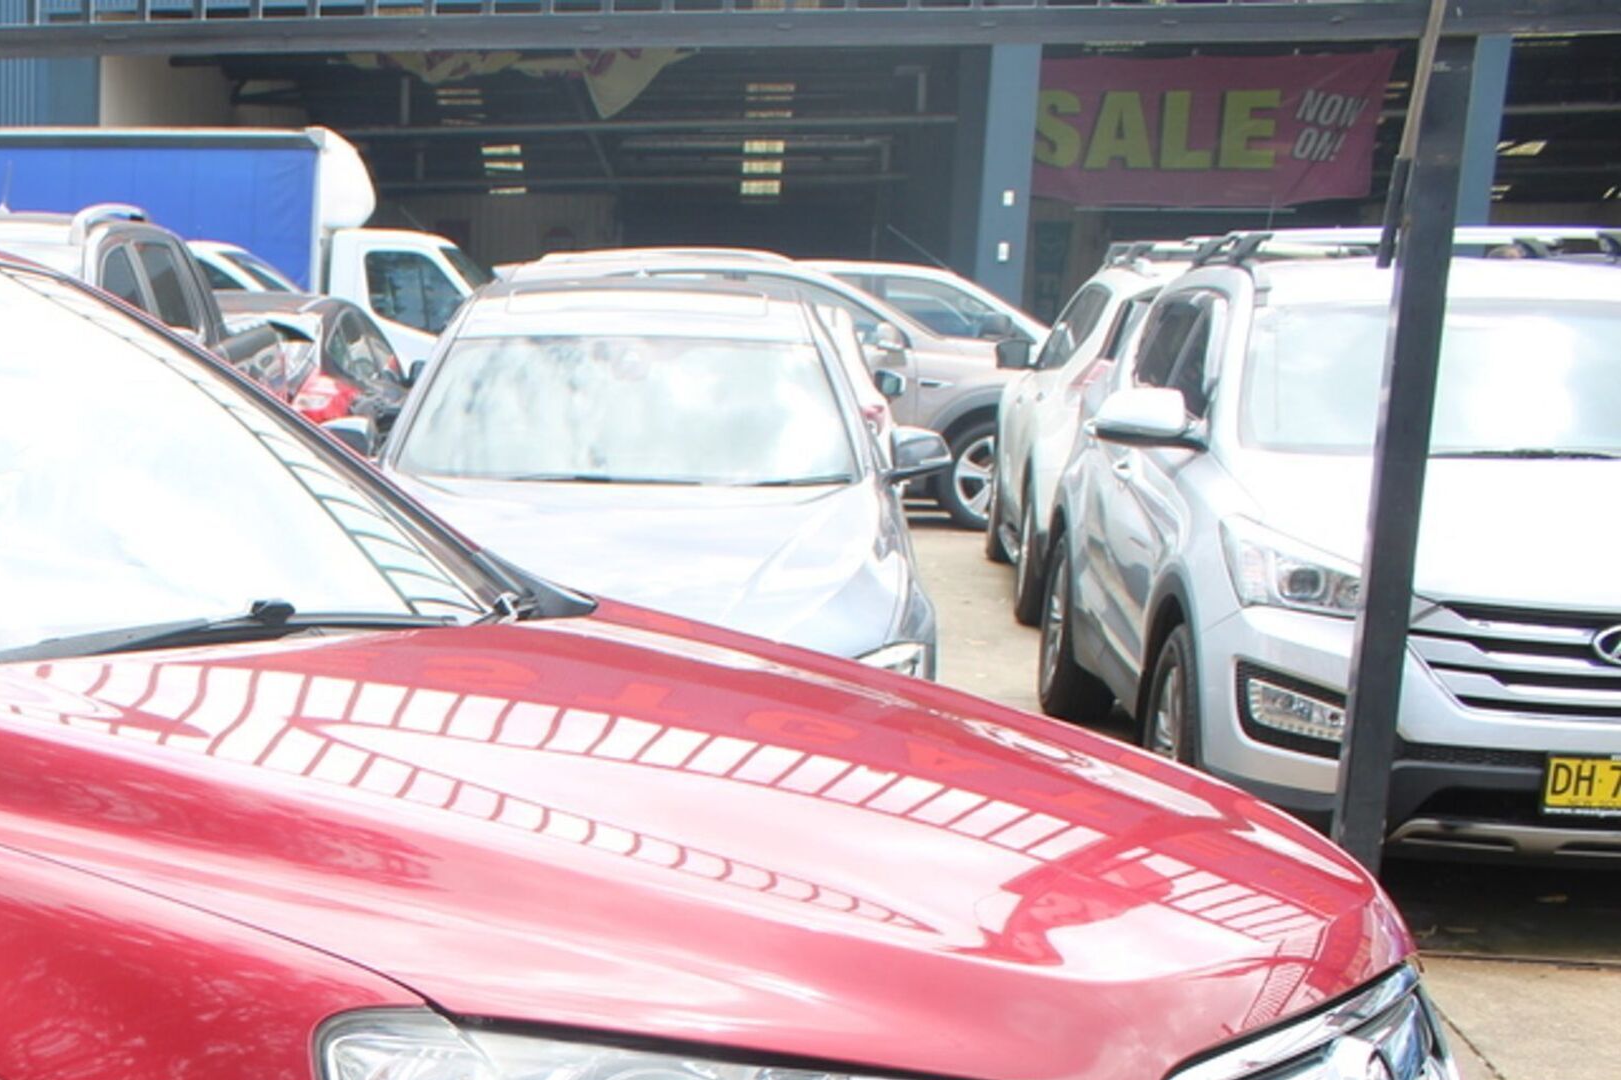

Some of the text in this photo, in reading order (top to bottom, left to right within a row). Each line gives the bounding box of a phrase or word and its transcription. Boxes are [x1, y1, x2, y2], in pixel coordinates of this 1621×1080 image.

[1295, 88, 1369, 127] NOW
[1035, 89, 1281, 169] SALE
[1291, 127, 1347, 162] ON!
